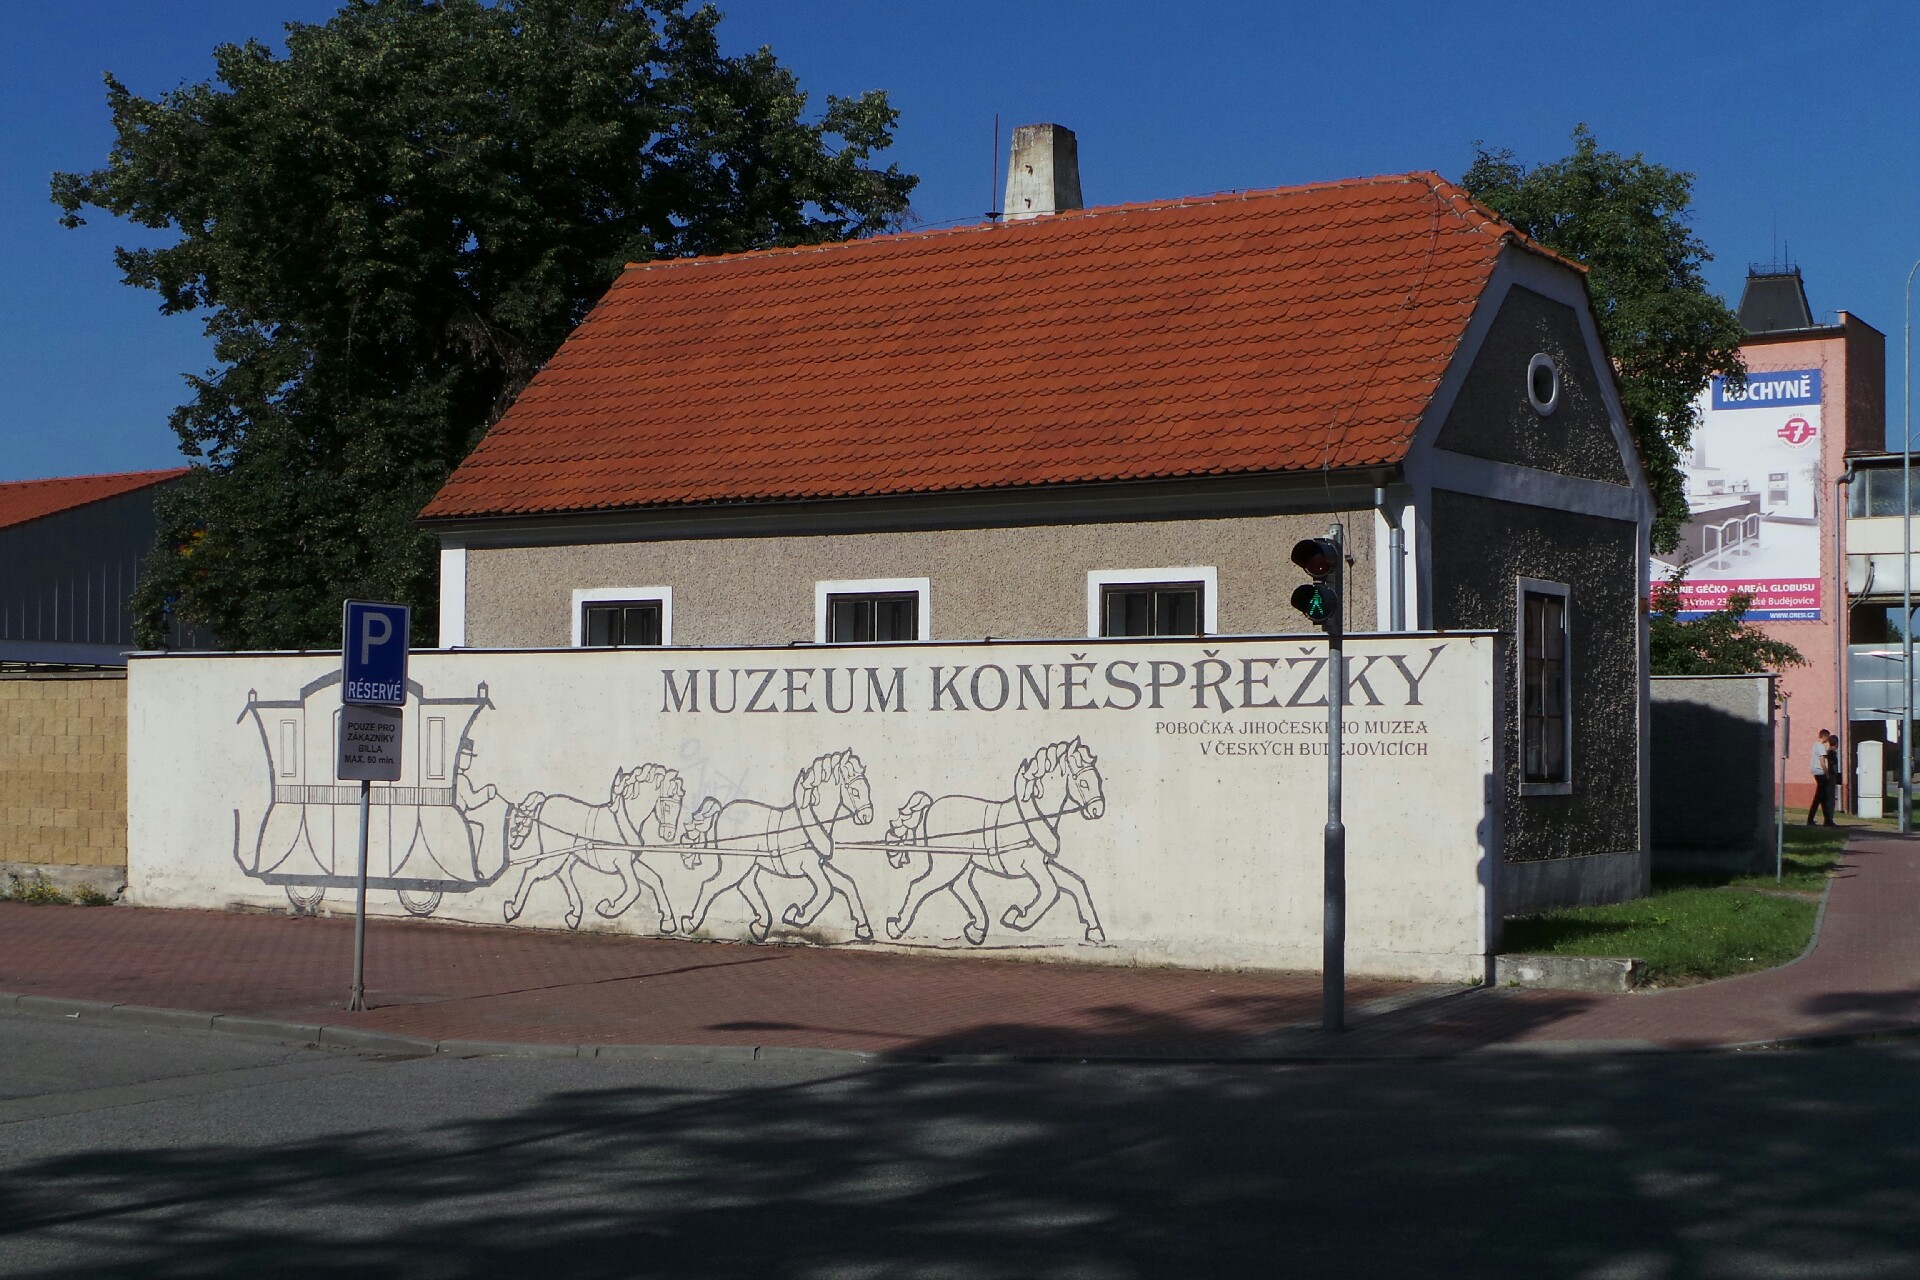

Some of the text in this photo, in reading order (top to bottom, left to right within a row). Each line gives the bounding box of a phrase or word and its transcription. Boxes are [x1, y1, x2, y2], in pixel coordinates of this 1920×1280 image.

[1790, 421, 1805, 442] 7
[1696, 583, 1728, 594] GÉČKO
[1738, 583, 1768, 593] AREÁL
[1770, 583, 1815, 593] GLOBUSU
[1768, 596, 1815, 607] Budějovice
[361, 612, 392, 665] P
[660, 642, 1450, 714] MUZEUM KONĚSPŘEŽKY
[348, 677, 401, 700] RÉSERVÉ
[347, 722, 396, 732] POUZE PRO
[1155, 720, 1235, 735] POBOČKA
[1364, 720, 1429, 735] MUZEA
[347, 731, 395, 742] ZÁKAZNÍKY
[358, 744, 383, 753] BILLA
[1200, 740, 1213, 756] V
[1215, 739, 1295, 756] ČESKÝCH
[344, 754, 365, 763] MAX.
[367, 755, 377, 764] 60
